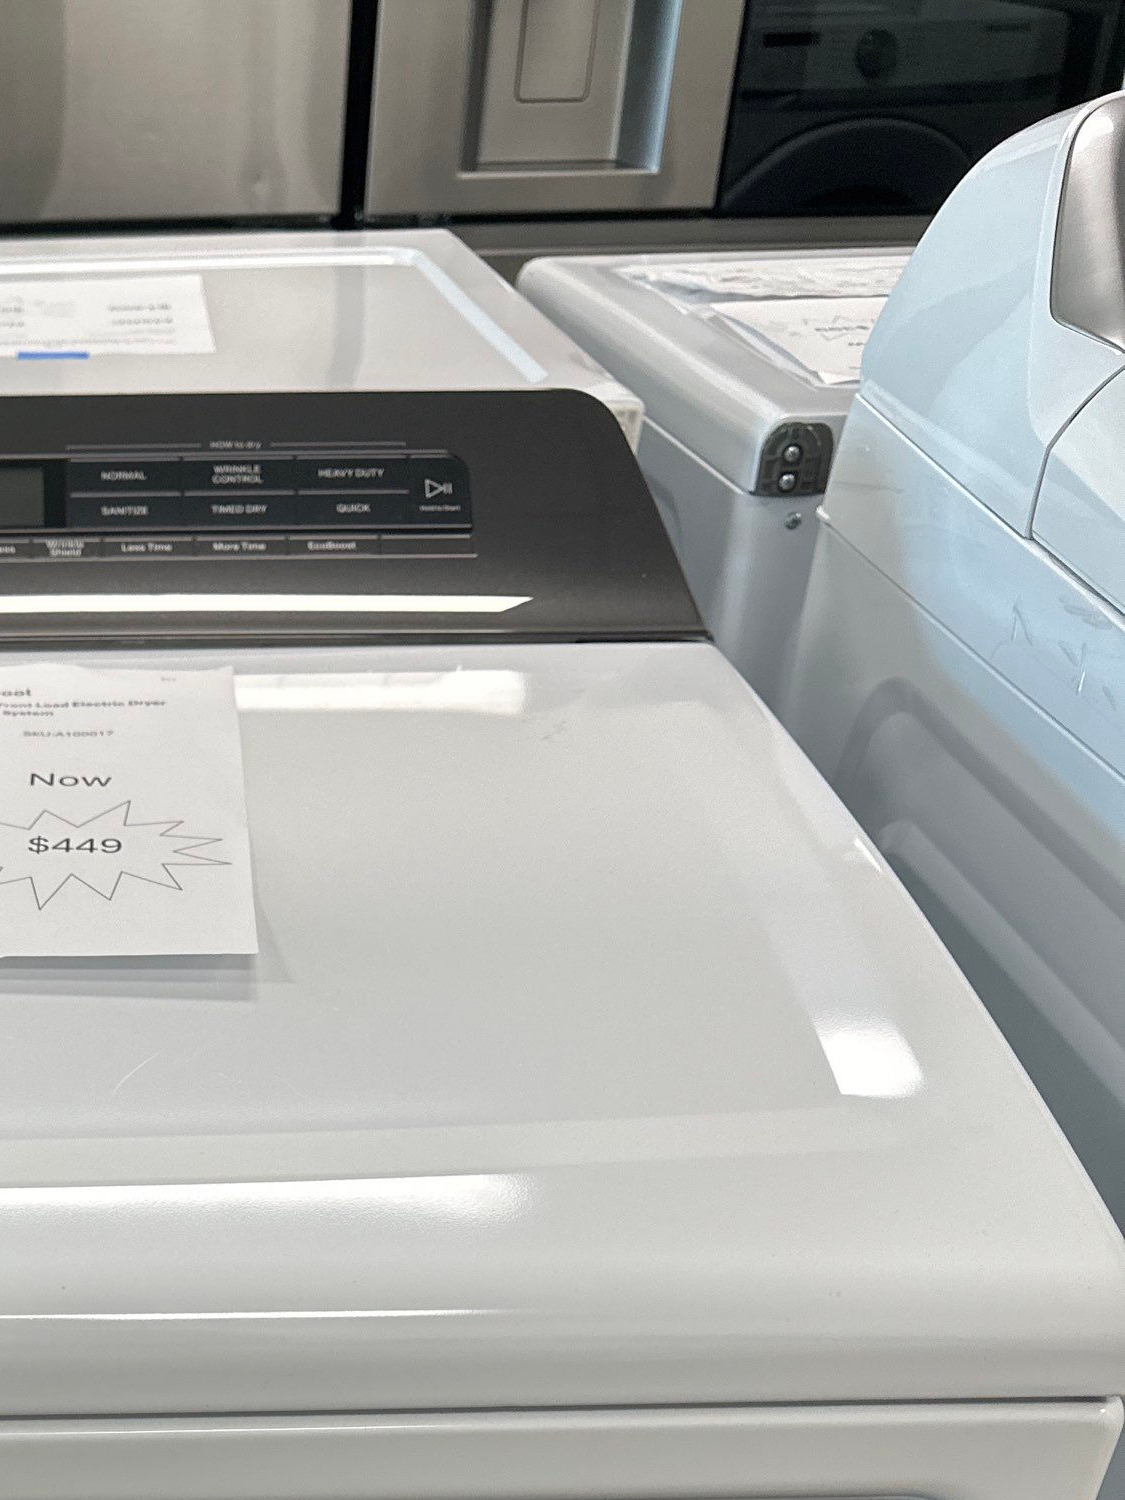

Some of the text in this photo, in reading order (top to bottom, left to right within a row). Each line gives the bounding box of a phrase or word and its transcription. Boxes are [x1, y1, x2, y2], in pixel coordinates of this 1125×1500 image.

[213, 464, 261, 474] WRINKLE
[318, 468, 385, 478] HEAVY DUTY
[100, 471, 147, 481] NORMAL
[211, 474, 264, 484] CONTROL
[100, 505, 149, 516] SANITIZE
[211, 504, 267, 514] TIMED DRY
[335, 503, 371, 513] QUICK
[120, 542, 173, 552] Less Time
[212, 541, 267, 551] More Time
[71, 700, 125, 708] Electric
[127, 700, 166, 708] Dryer
[30, 772, 112, 787] Now
[28, 835, 123, 855] $449
